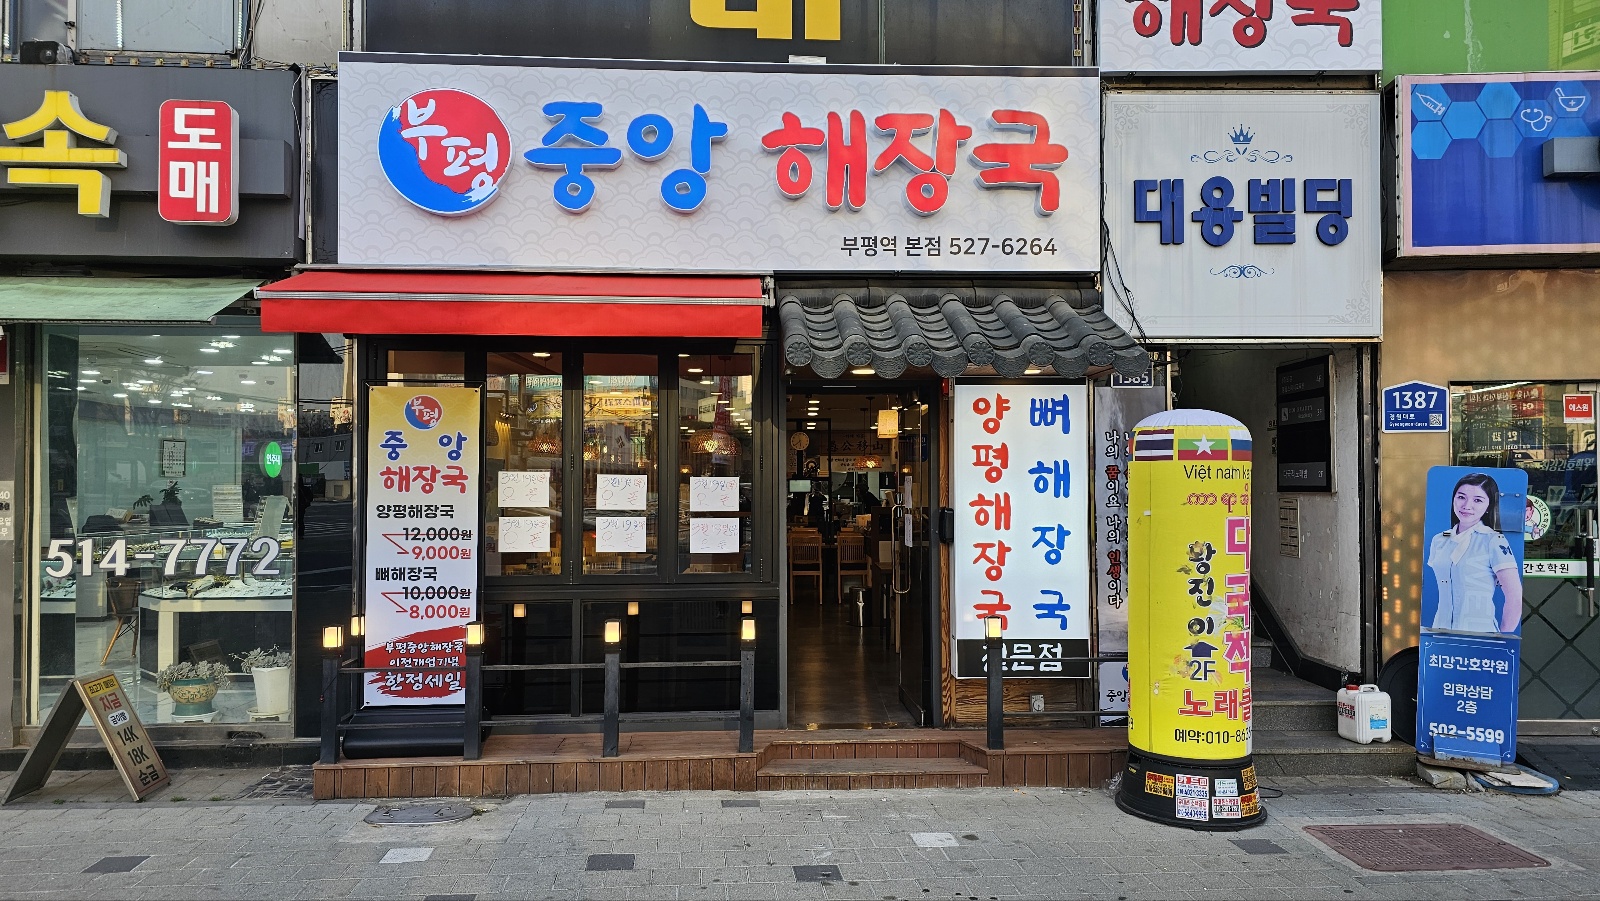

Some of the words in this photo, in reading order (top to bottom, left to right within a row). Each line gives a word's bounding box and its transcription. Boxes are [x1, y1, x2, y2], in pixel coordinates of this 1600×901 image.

[167, 107, 222, 213] 도매
[401, 98, 499, 191] 부평
[523, 100, 728, 214] 중앙
[761, 108, 1069, 216] 해장국
[1133, 176, 1353, 246] 대용빌딩
[840, 236, 898, 257] 부평역
[904, 236, 942, 257] 본점
[949, 239, 1058, 256] 527-6264
[1393, 391, 1438, 409] 1387
[411, 398, 440, 429] 부평
[379, 430, 468, 461] 중앙
[1105, 430, 1120, 459] 나의
[379, 464, 469, 494] 해장국
[1183, 464, 1212, 482] Việt
[1216, 465, 1240, 479] nam
[1105, 465, 1121, 508] 꿈이요
[376, 504, 455, 519] 양평해장국
[969, 393, 1012, 631] 양평해장국
[1028, 393, 1072, 631] 뼈해장국
[402, 527, 472, 542] 12,000원
[1106, 515, 1121, 544] 나의
[45, 537, 280, 577] 514-7772
[412, 545, 471, 560] 9,000원
[375, 566, 438, 581] 뼈해장국
[1107, 549, 1123, 610] 인생이다
[402, 585, 471, 600] 10,000원
[409, 604, 471, 619] 8,000원
[385, 641, 464, 654] 부평중앙해장국
[389, 655, 460, 668] 이전개업기념
[1190, 660, 1216, 681] 2F
[1429, 653, 1508, 675] 최강간호학원
[384, 671, 463, 691] 한정세일
[1443, 682, 1493, 700] 입학상담
[1456, 699, 1478, 714] 2층
[117, 725, 139, 746] 14K
[1428, 721, 1505, 745] 502-5599
[128, 745, 149, 766] 18K
[139, 763, 160, 786] 순금
